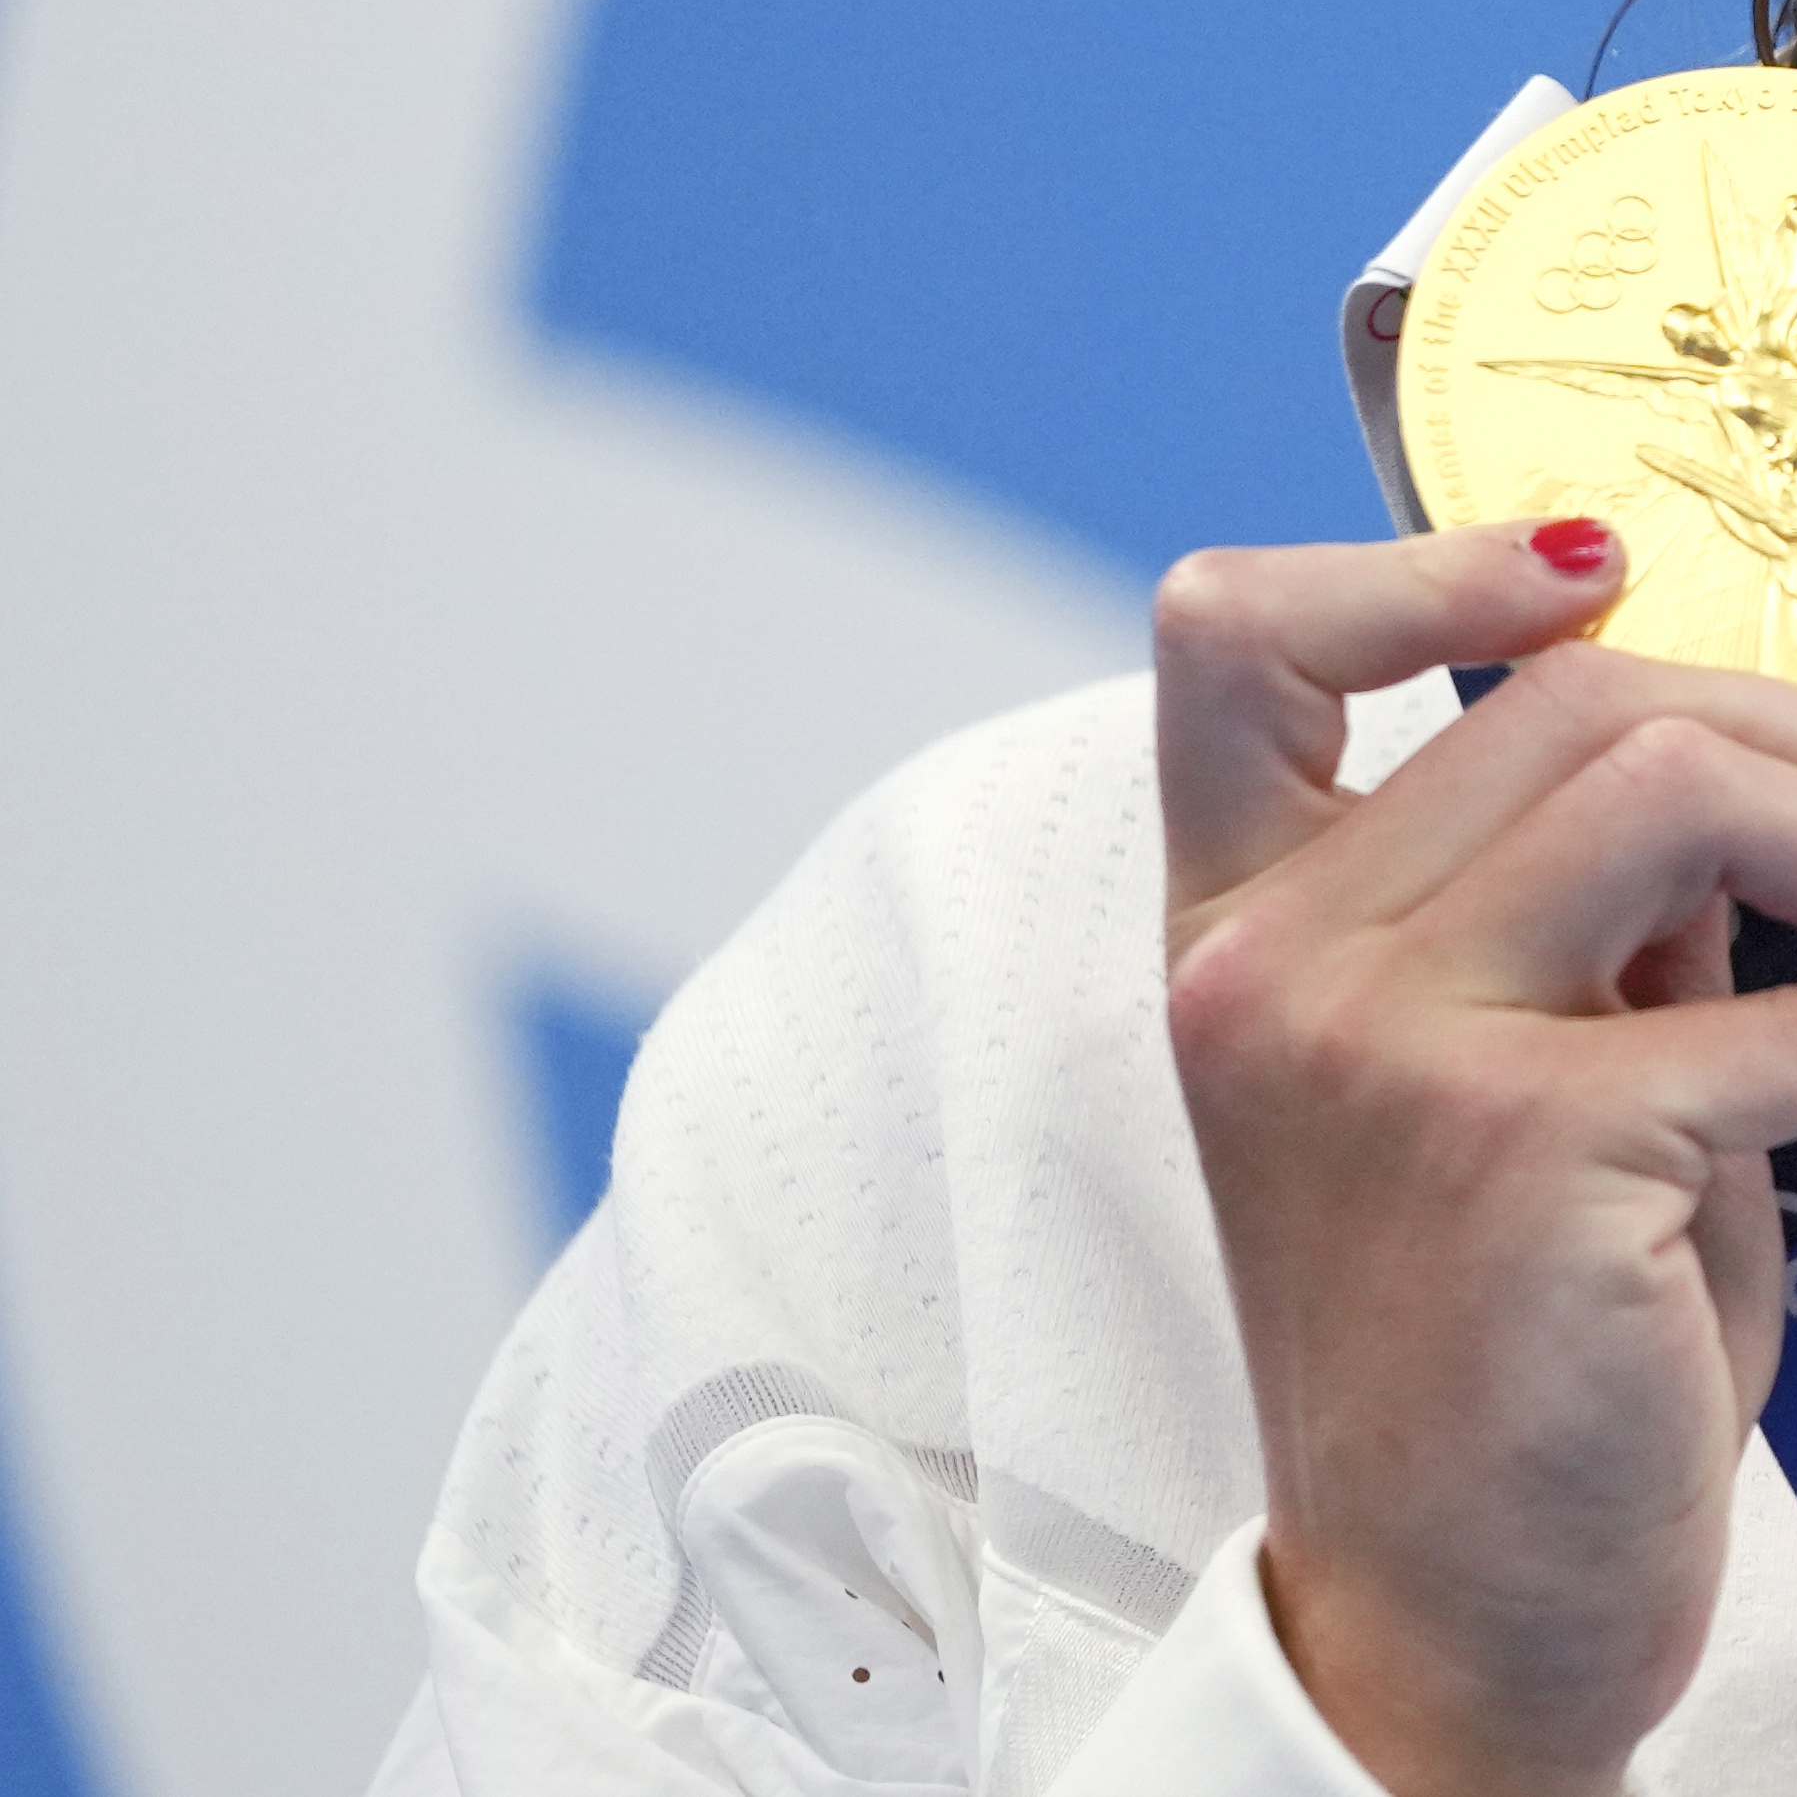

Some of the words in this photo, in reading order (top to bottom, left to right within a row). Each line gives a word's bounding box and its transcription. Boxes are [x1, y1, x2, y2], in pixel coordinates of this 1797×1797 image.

[1668, 86, 1777, 117] Tokyo
[1502, 93, 1662, 199] Olympiad
[1439, 197, 1513, 284] XXXII
[1421, 292, 1464, 346] the
[1416, 363, 1451, 395] of
